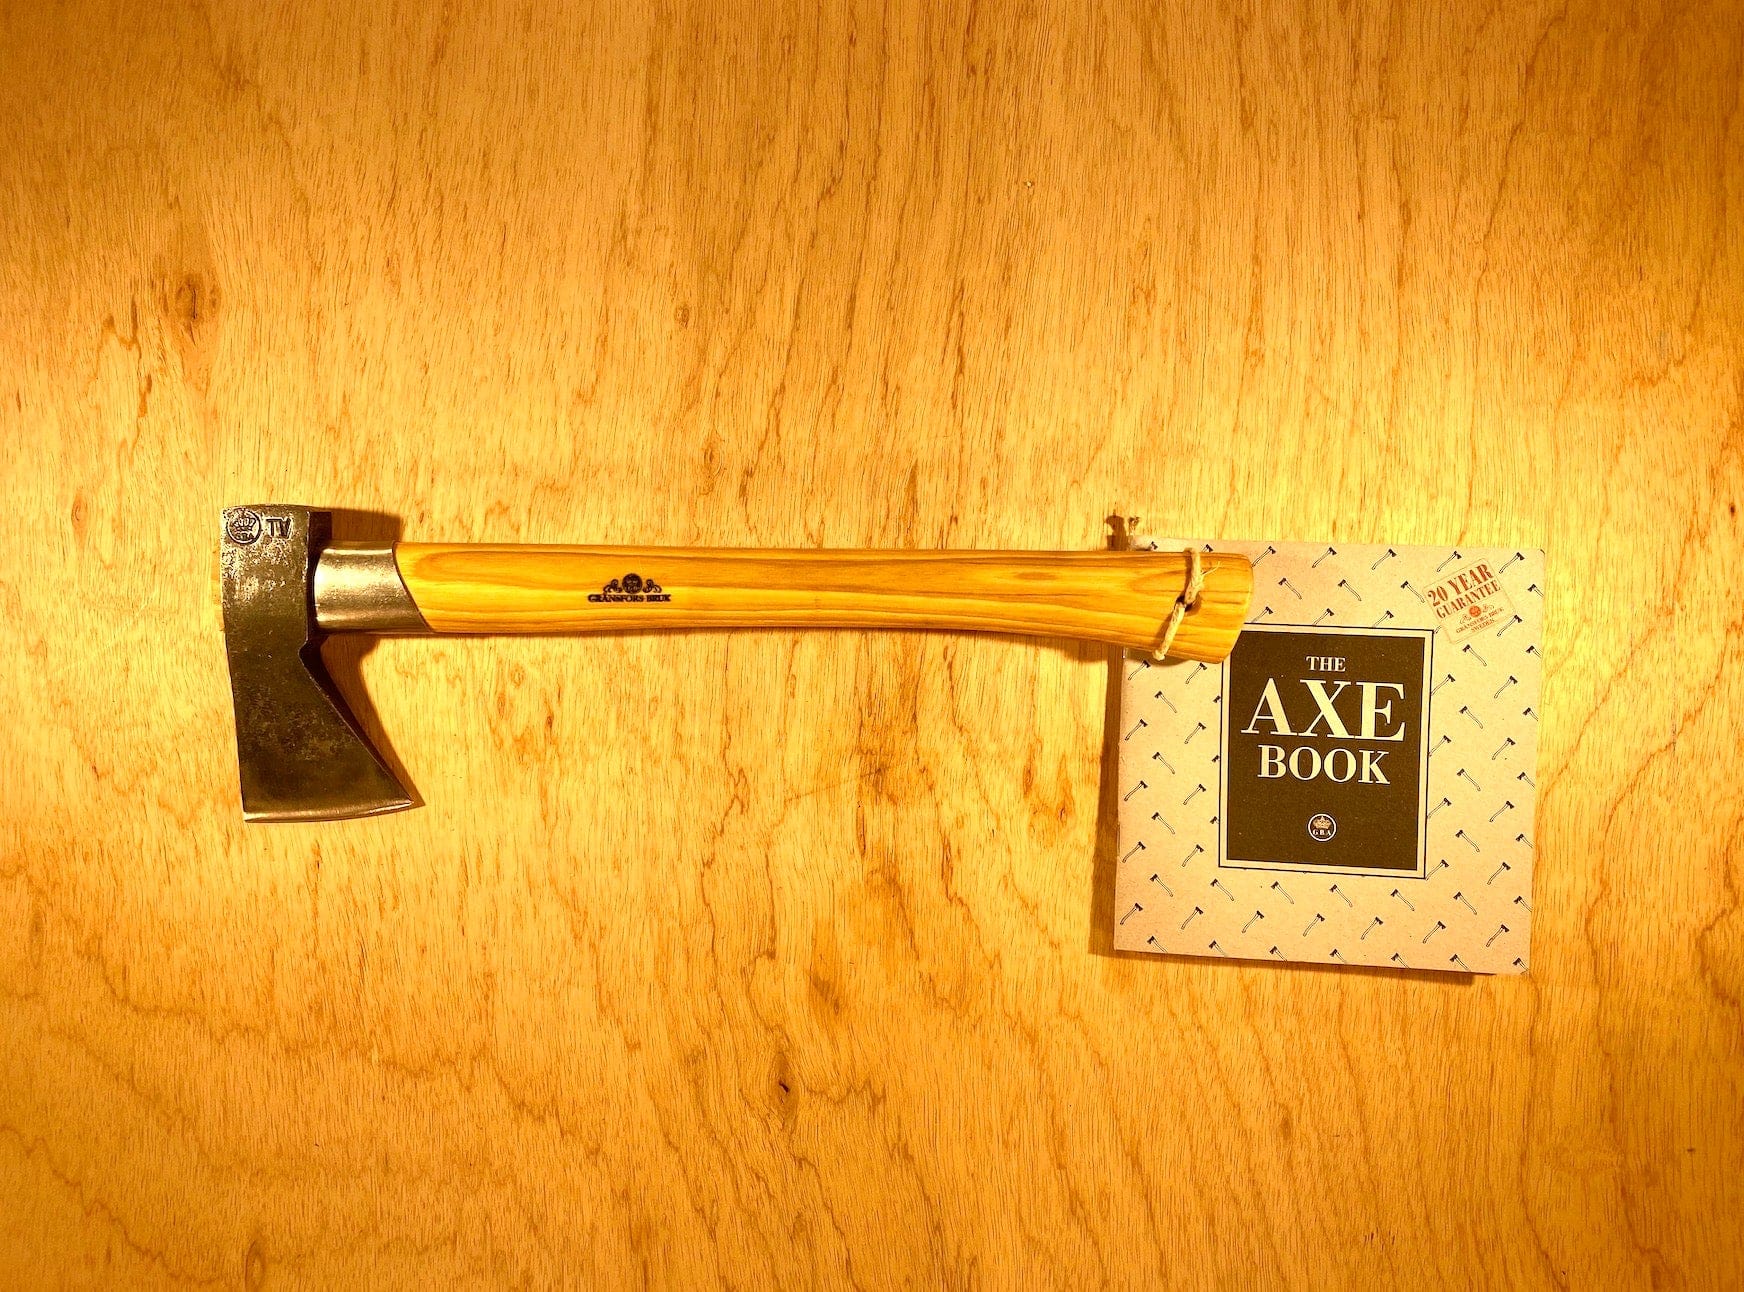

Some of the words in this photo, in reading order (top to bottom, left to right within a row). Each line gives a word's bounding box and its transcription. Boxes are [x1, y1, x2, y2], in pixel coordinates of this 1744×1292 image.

[266, 517, 292, 539] TV
[646, 594, 671, 602] BRUK
[1427, 585, 1449, 607] 20
[1447, 563, 1494, 596] YEAR
[1436, 579, 1501, 619] GUARANTEE
[1305, 655, 1346, 672] THE
[1240, 677, 1406, 742] AXE
[1257, 744, 1391, 785] BOOK
